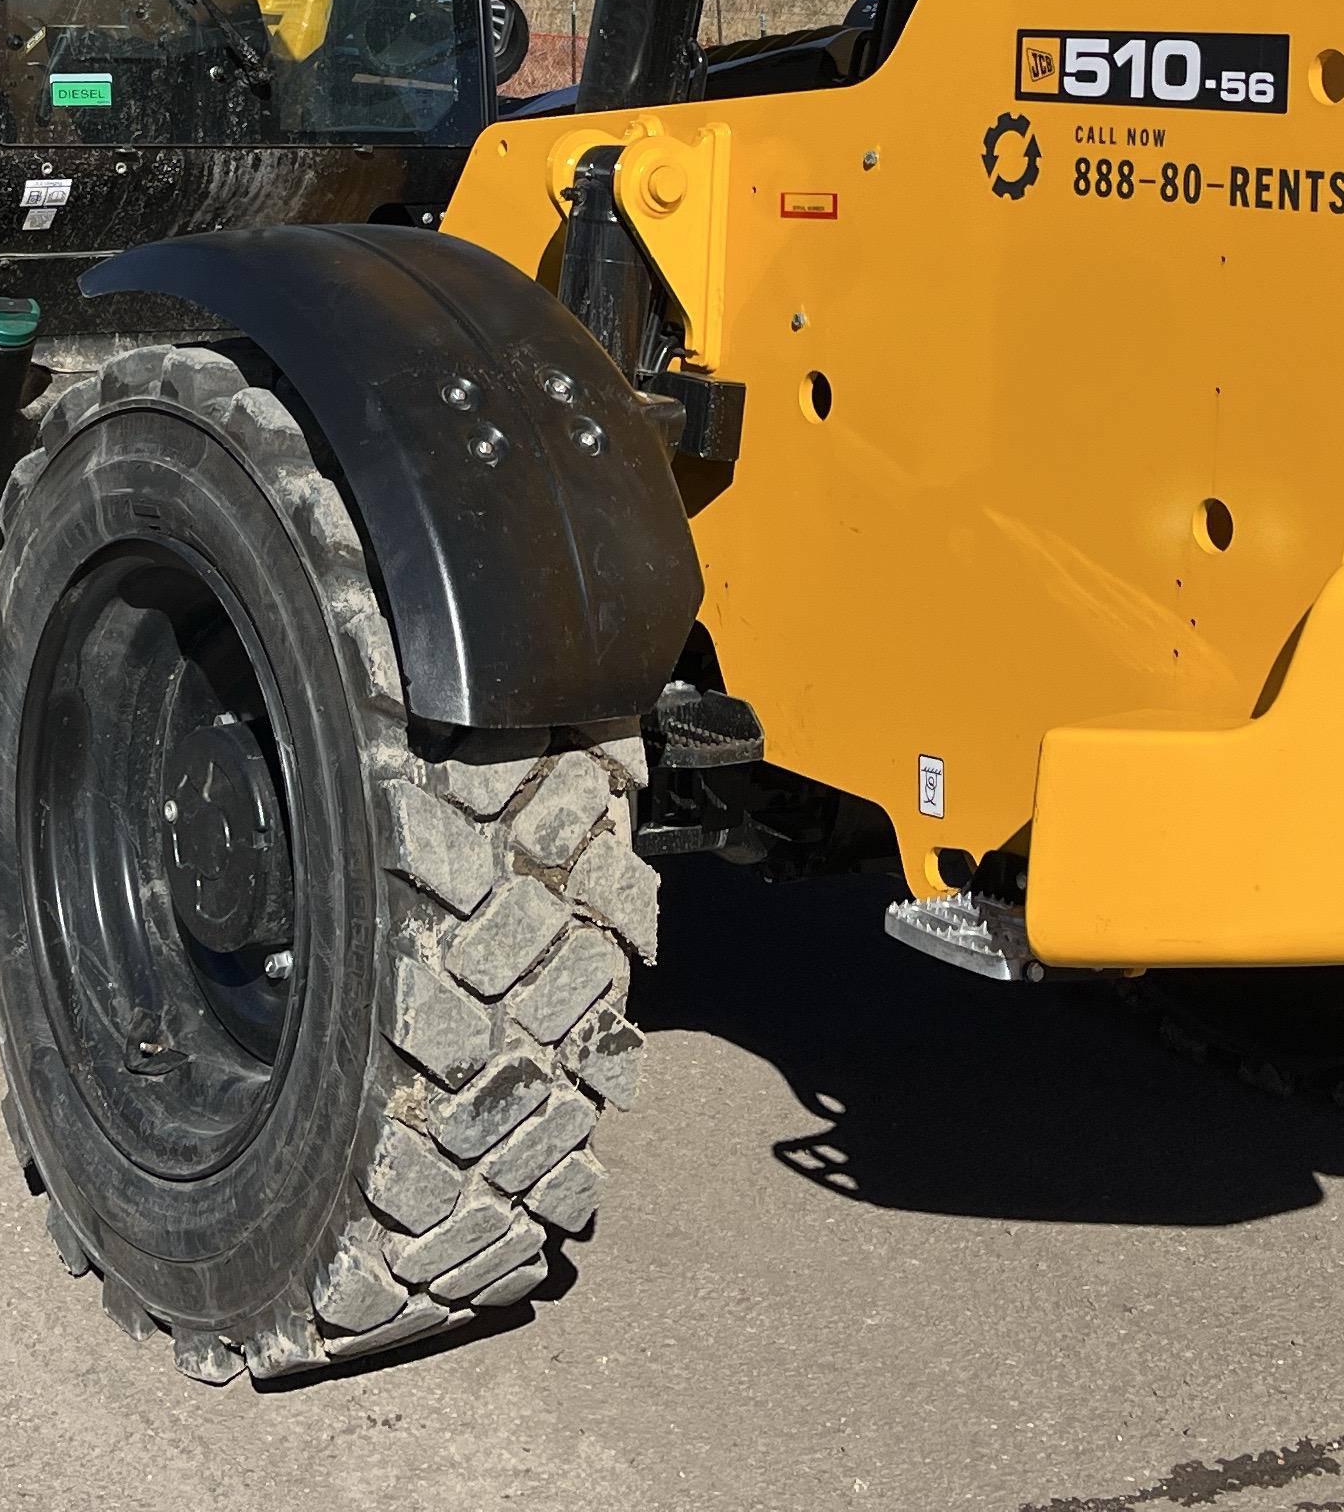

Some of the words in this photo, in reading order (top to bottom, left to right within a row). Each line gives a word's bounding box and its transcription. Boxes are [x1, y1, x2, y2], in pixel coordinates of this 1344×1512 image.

[58, 89, 105, 99] DIESEL
[1074, 125, 1118, 145] CALL
[1126, 127, 1167, 148] NOW
